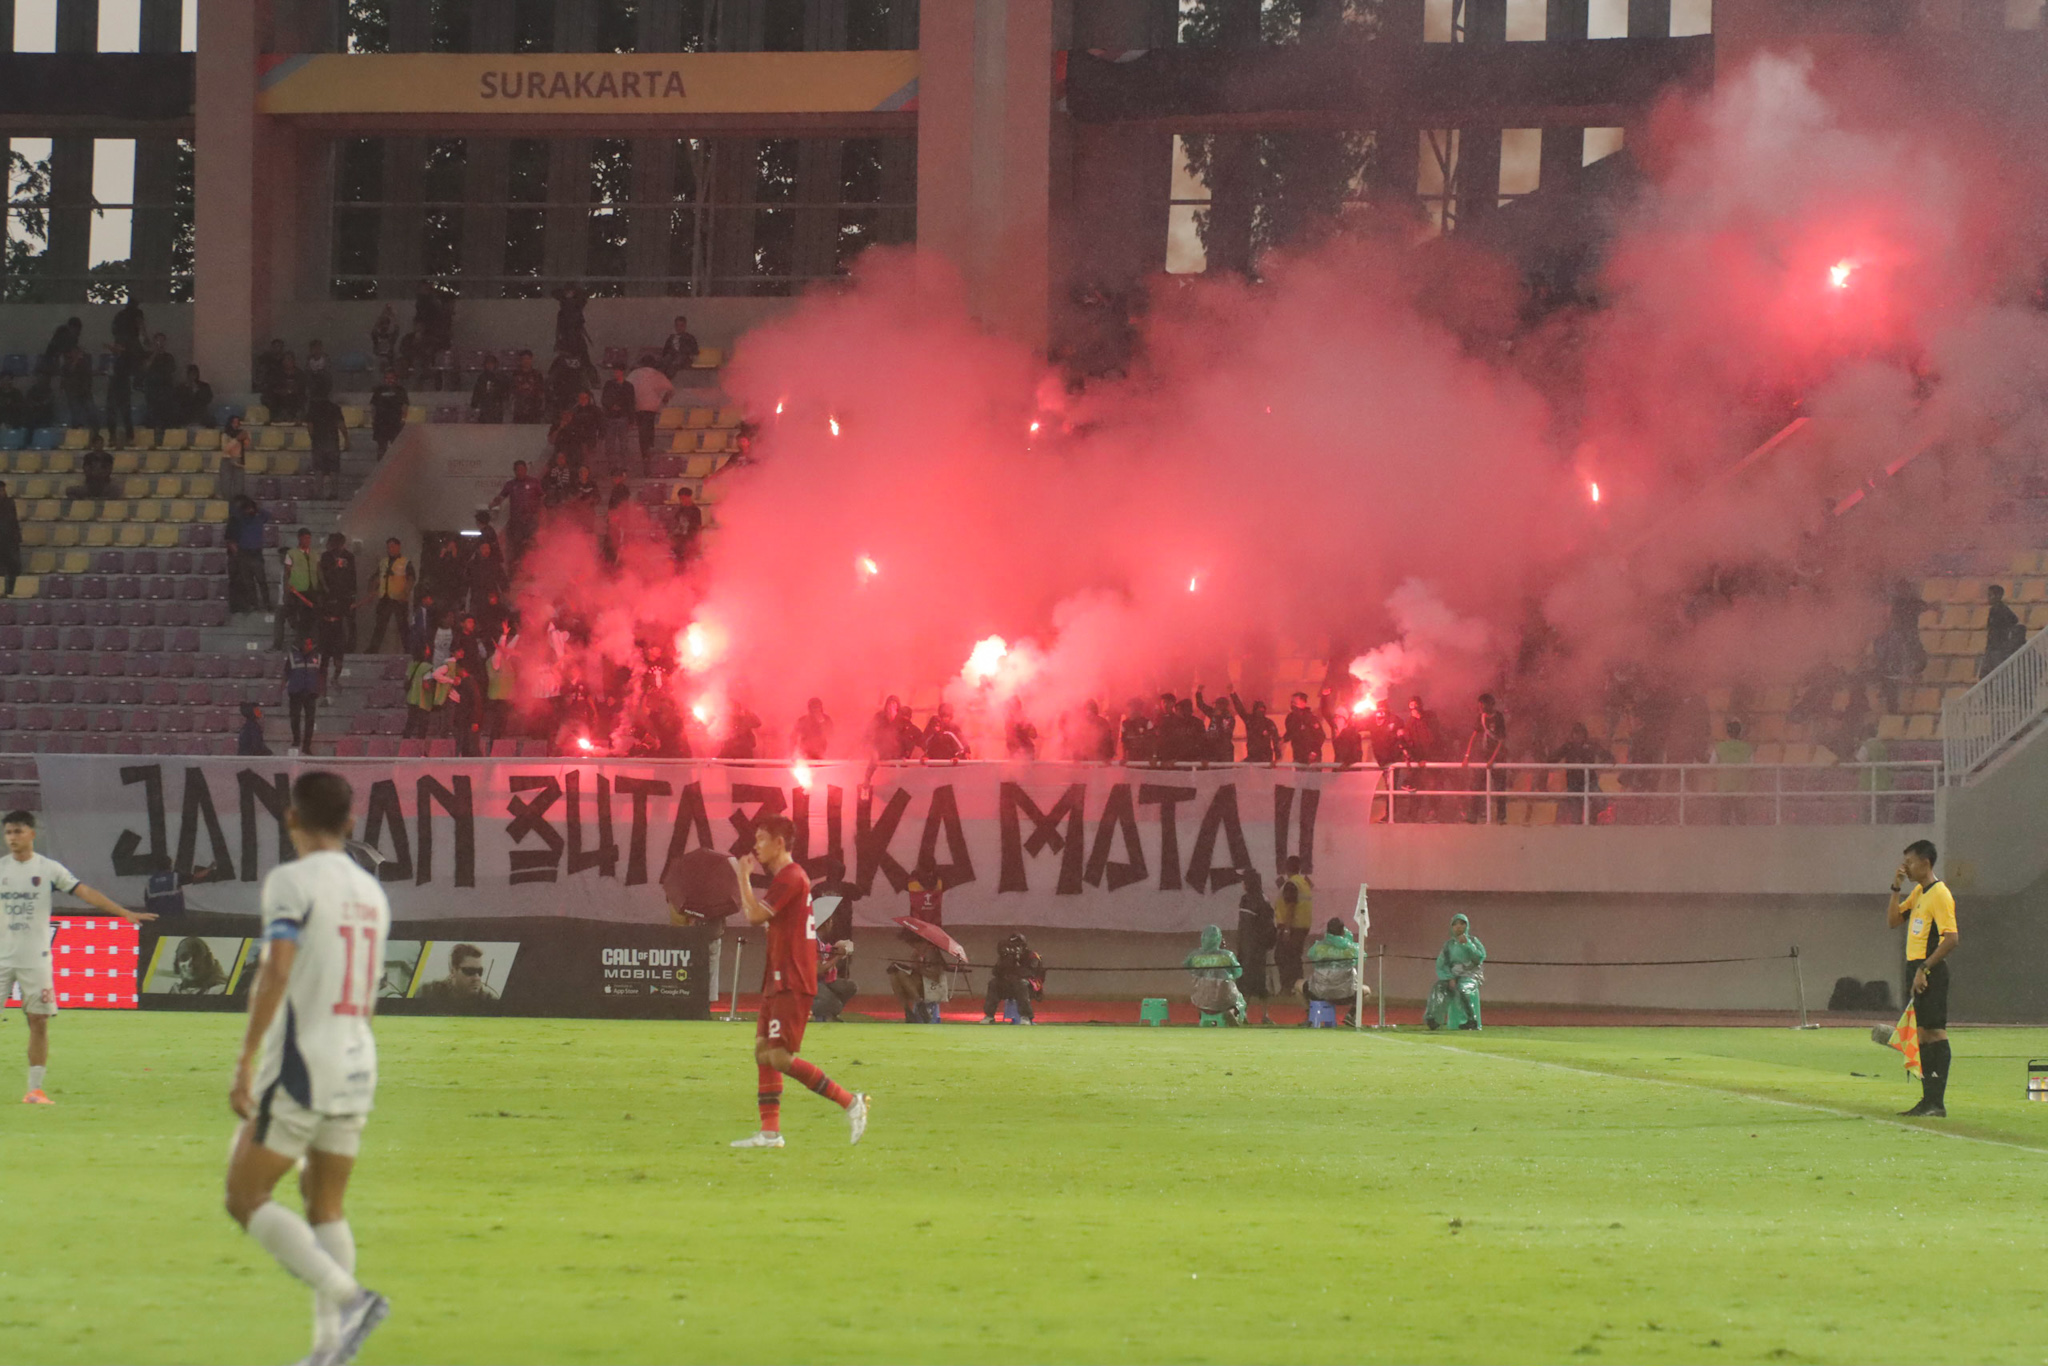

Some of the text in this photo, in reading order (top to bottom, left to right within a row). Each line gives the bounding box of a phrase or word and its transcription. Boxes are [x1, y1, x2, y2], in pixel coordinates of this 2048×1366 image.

[480, 71, 687, 99] SURAKARTA
[112, 764, 475, 888] JANAN
[998, 782, 1253, 896] MATA
[332, 925, 377, 1016] 11
[602, 948, 691, 967] CALL OF DUTY
[604, 969, 672, 979] MOBILE
